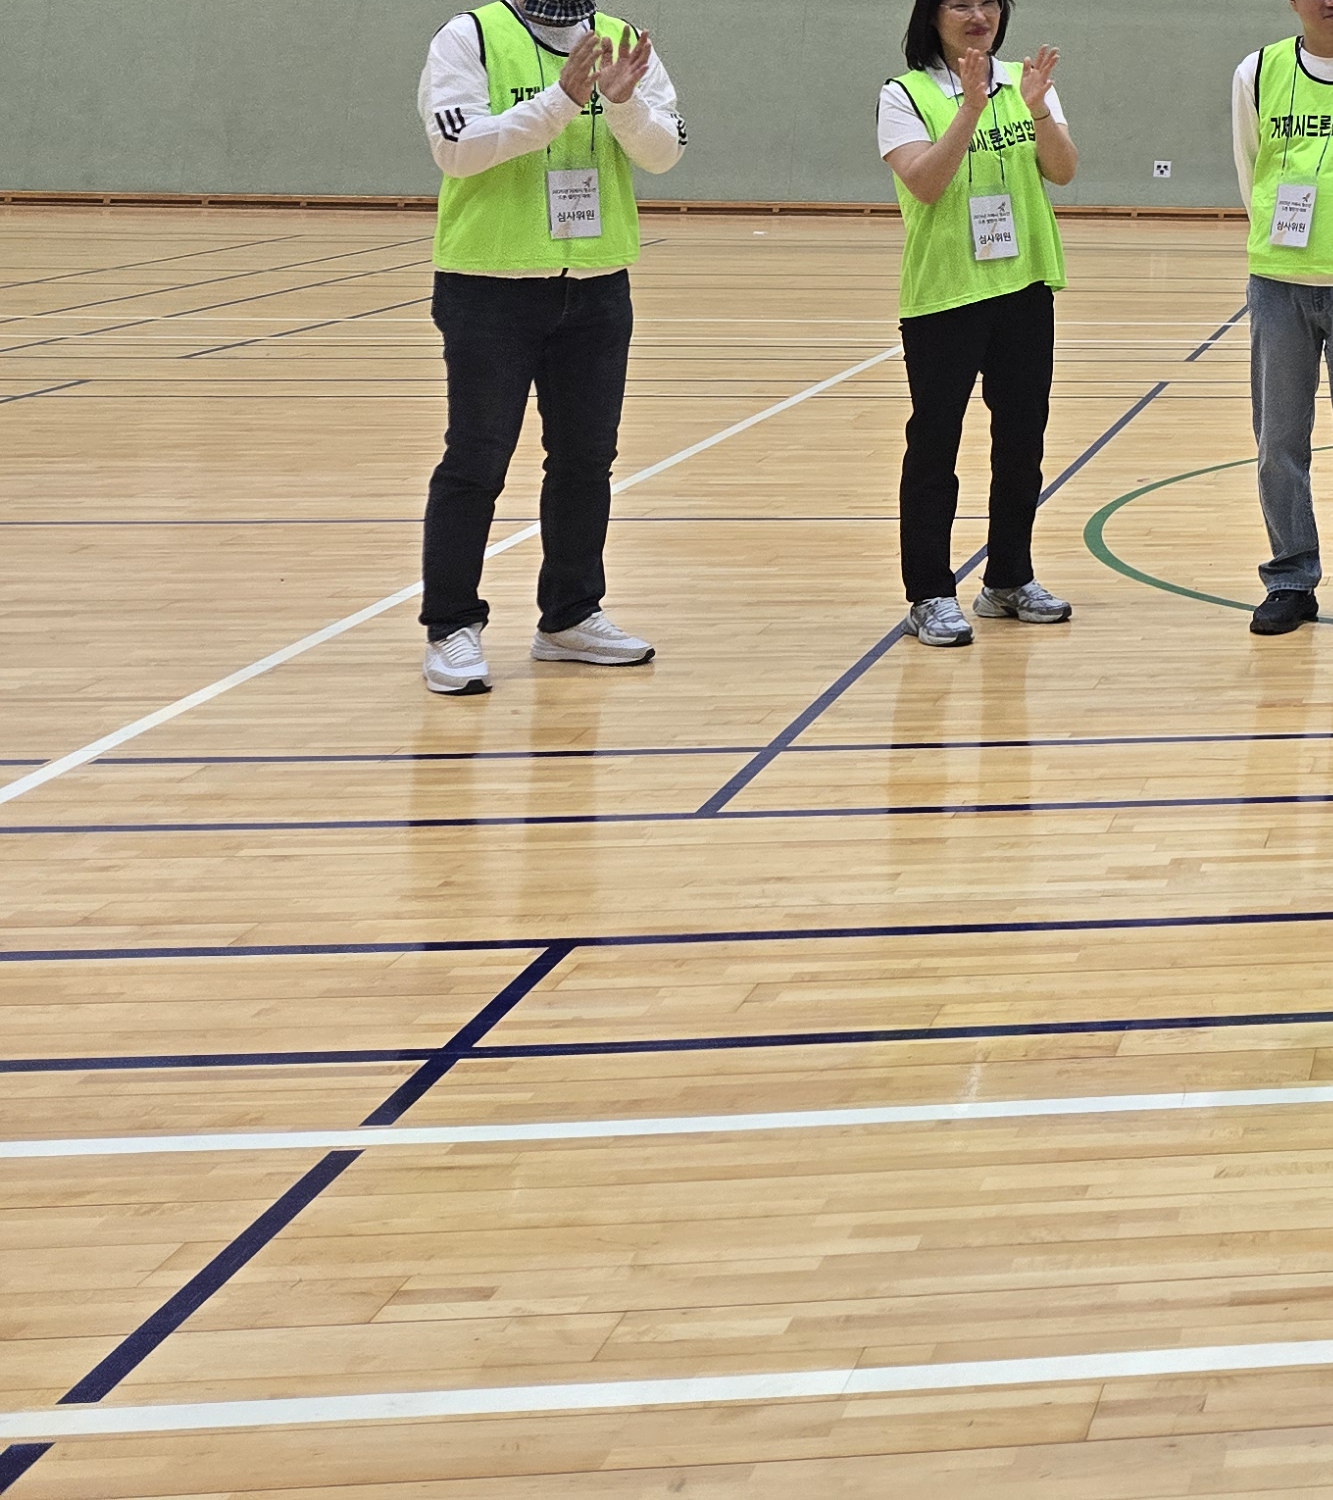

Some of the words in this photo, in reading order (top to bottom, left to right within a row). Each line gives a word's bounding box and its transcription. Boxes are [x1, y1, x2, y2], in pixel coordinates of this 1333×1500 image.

[556, 209, 596, 223] 심사위원
[1276, 220, 1307, 234] 심사위원
[978, 231, 1012, 245] 심사위원
